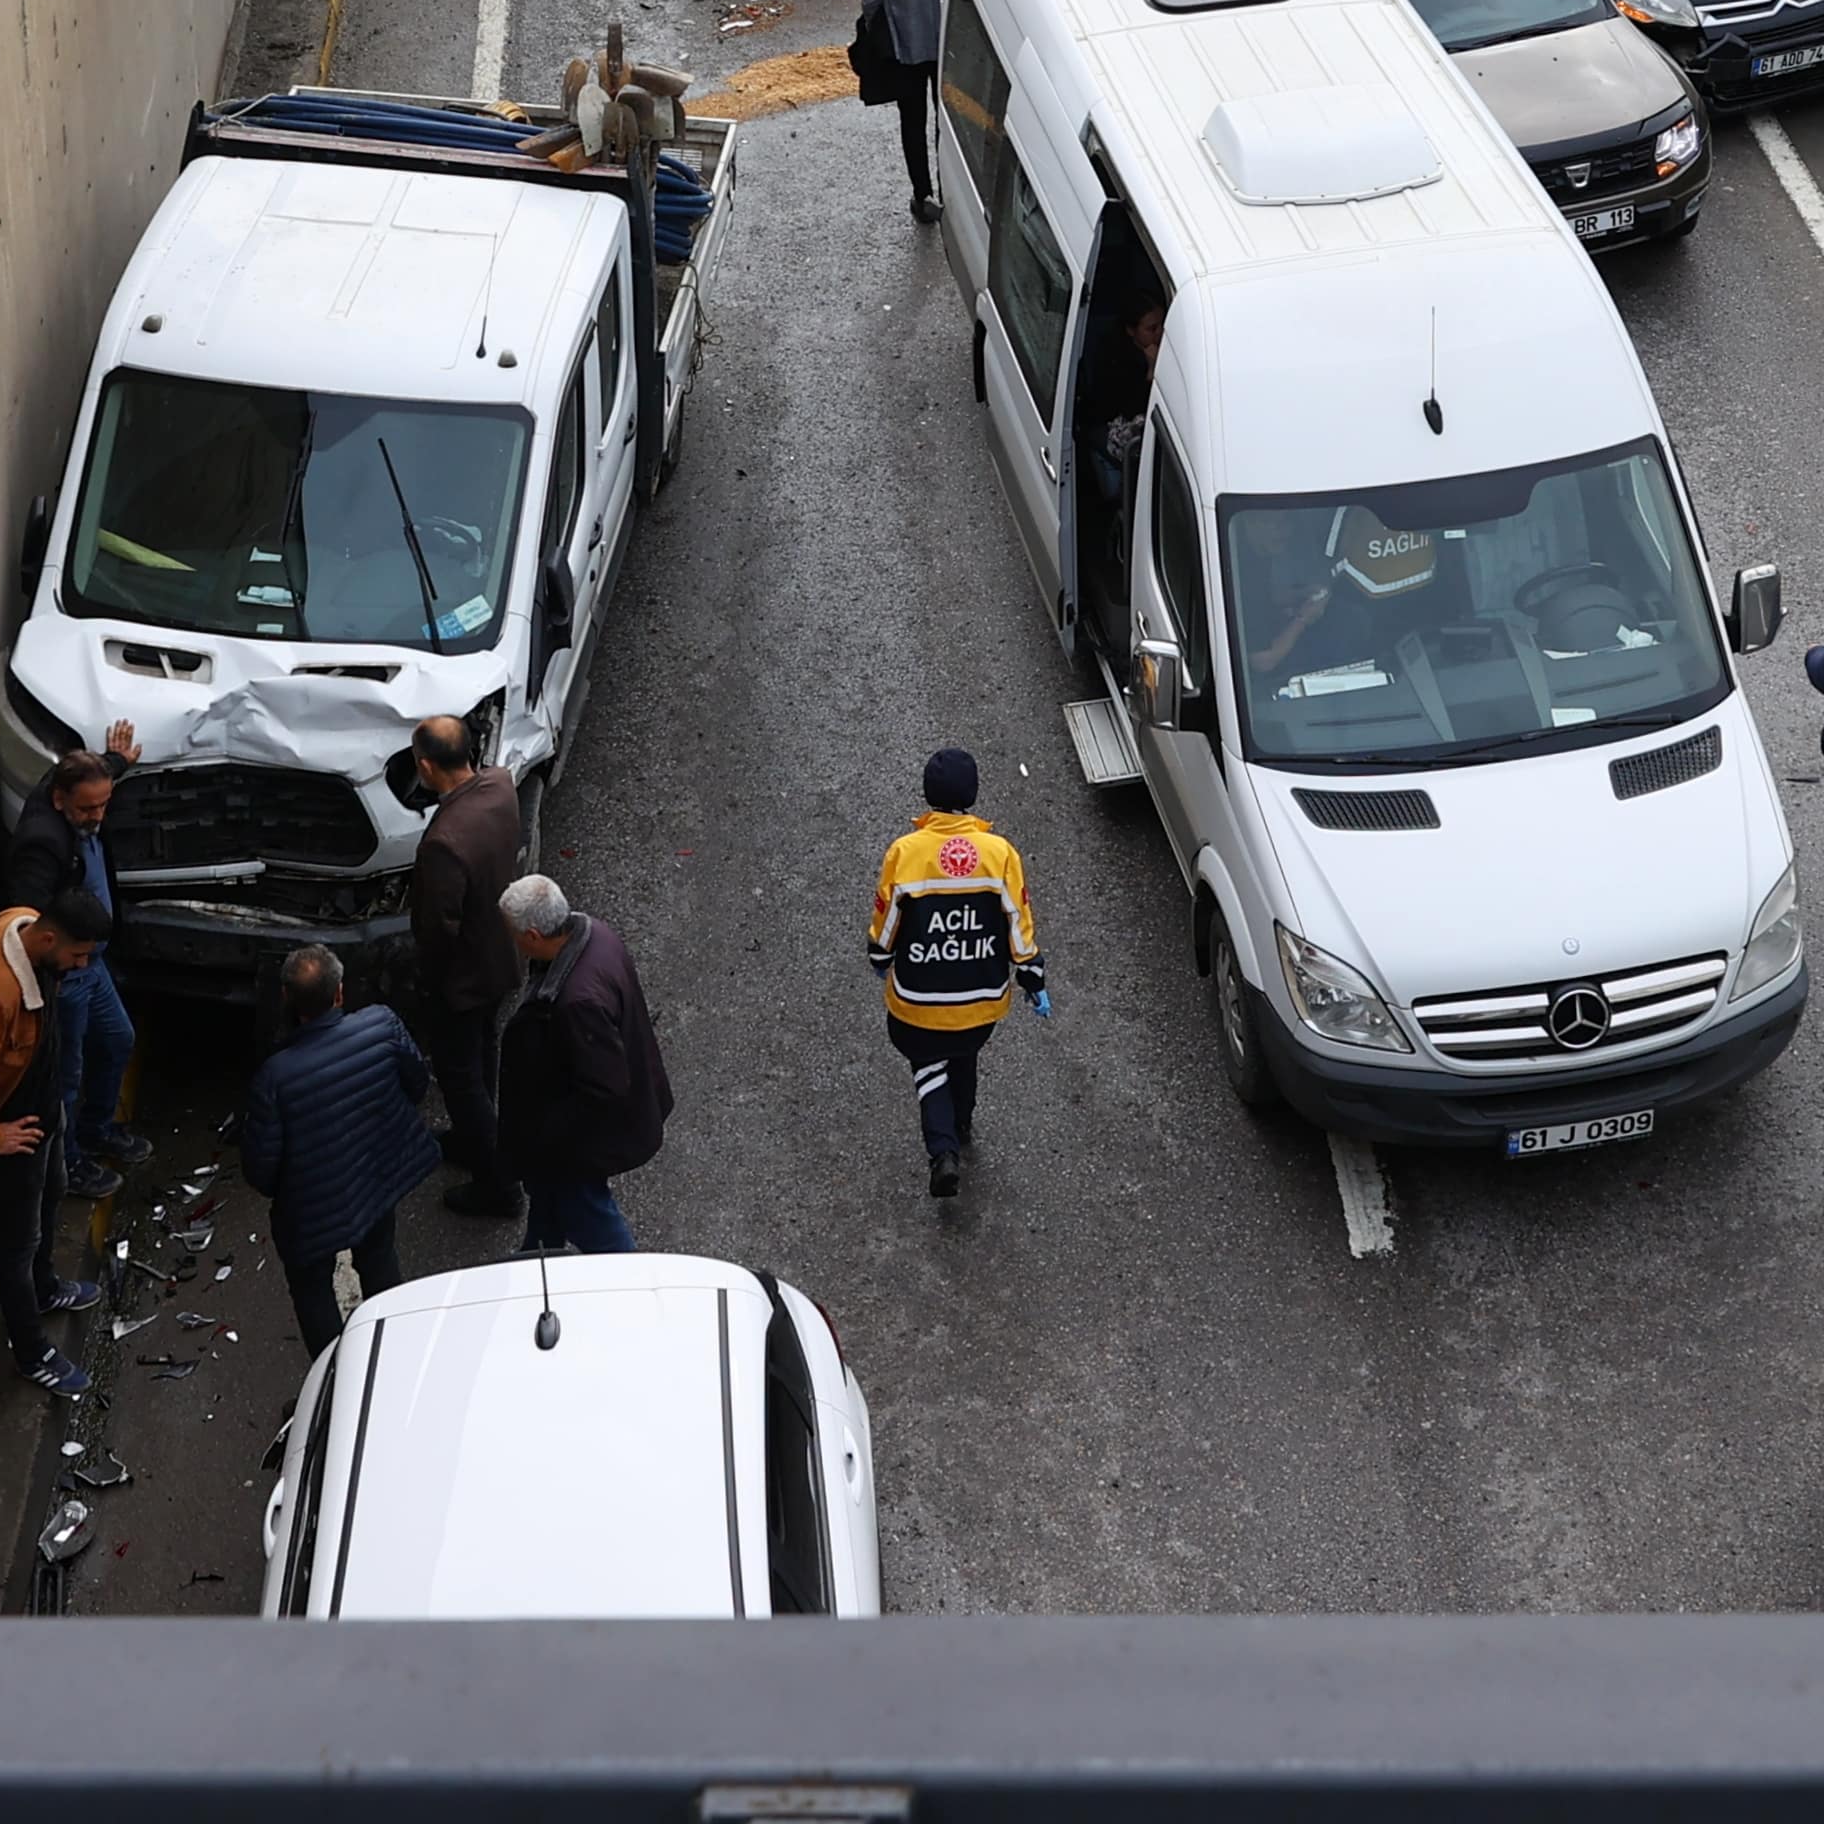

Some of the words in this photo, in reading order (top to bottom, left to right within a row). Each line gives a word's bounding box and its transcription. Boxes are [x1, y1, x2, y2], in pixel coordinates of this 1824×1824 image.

[1760, 57, 1774, 73] 61
[1575, 216, 1598, 234] BR
[1609, 207, 1633, 227] 113
[928, 904, 984, 934] ACİL
[908, 934, 996, 964] SAĞLIK
[1521, 1129, 1548, 1150] 61
[1559, 1125, 1575, 1144] J
[1586, 1112, 1652, 1140] 0309
